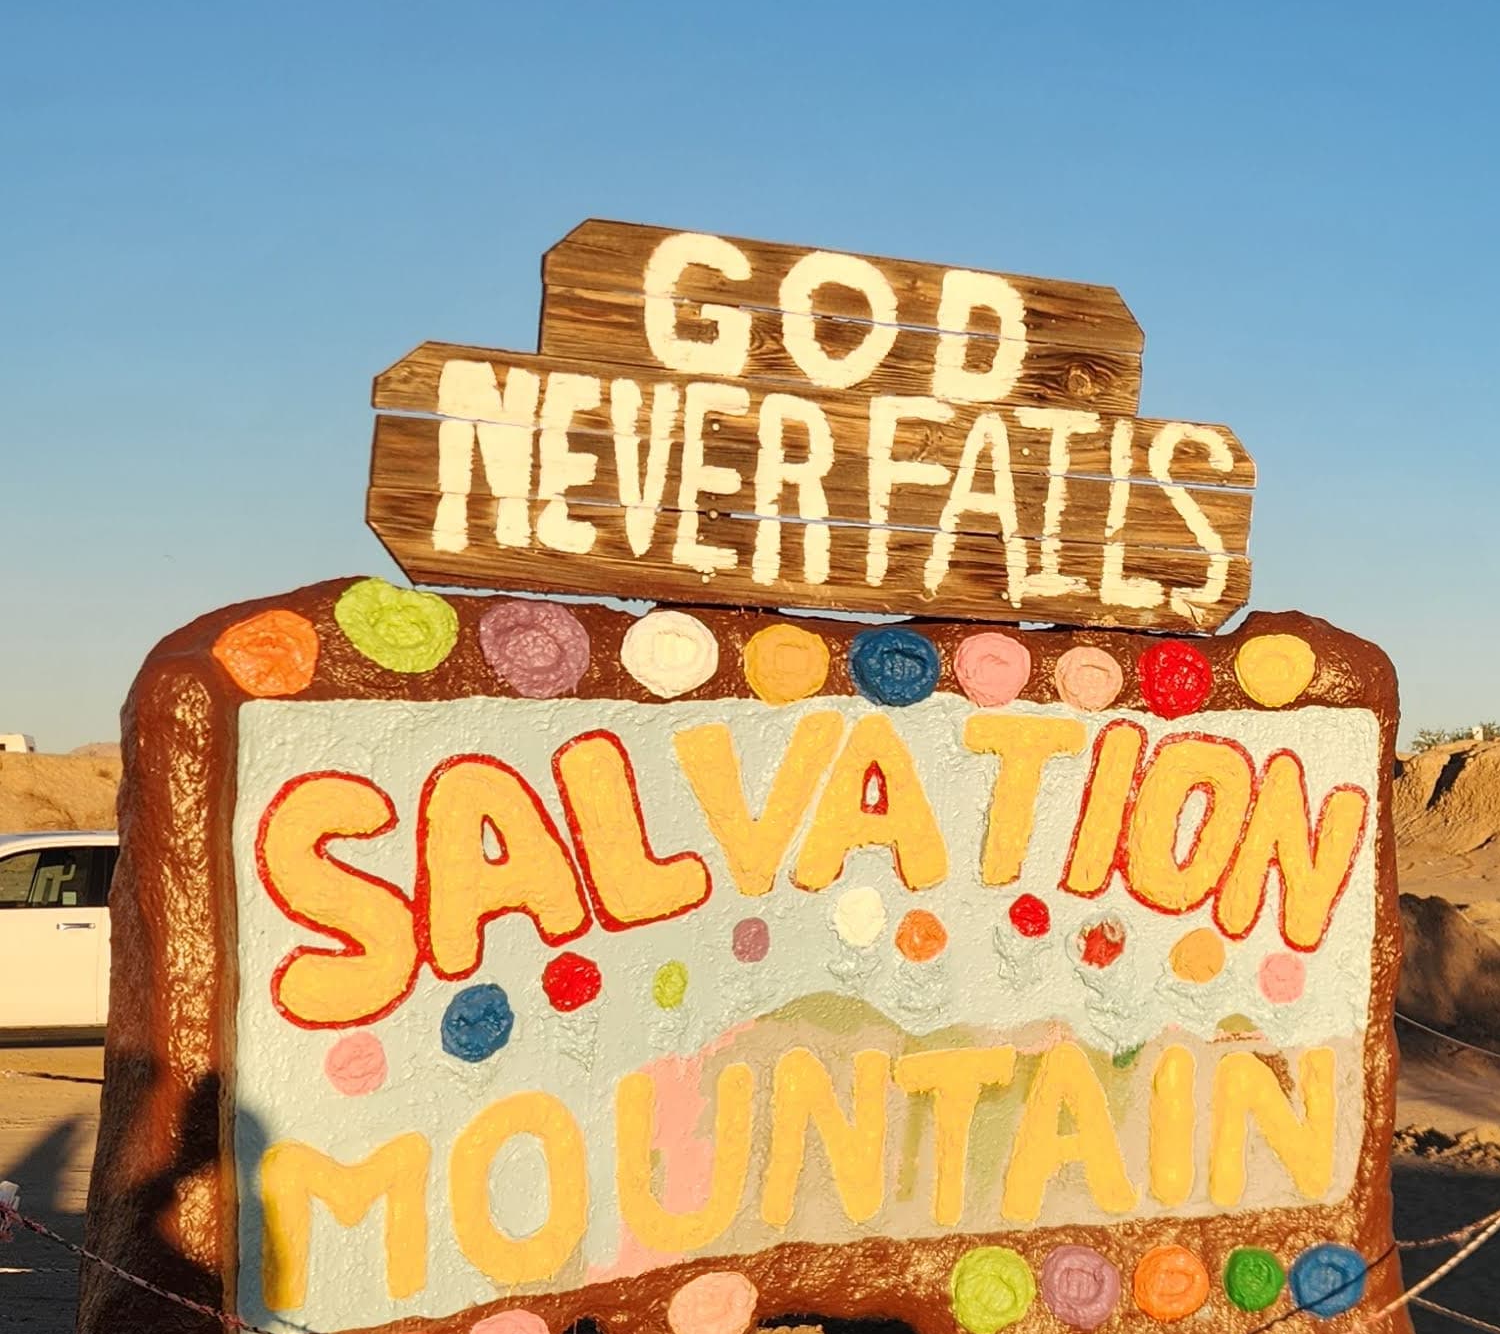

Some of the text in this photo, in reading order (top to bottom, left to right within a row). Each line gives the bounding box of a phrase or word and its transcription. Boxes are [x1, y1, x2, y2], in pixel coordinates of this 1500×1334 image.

[643, 232, 1028, 401] GOD
[430, 360, 1234, 620] NEVER FAILS
[255, 710, 1369, 1030] SALVATION
[260, 1043, 1336, 1311] MOUNTAIN
